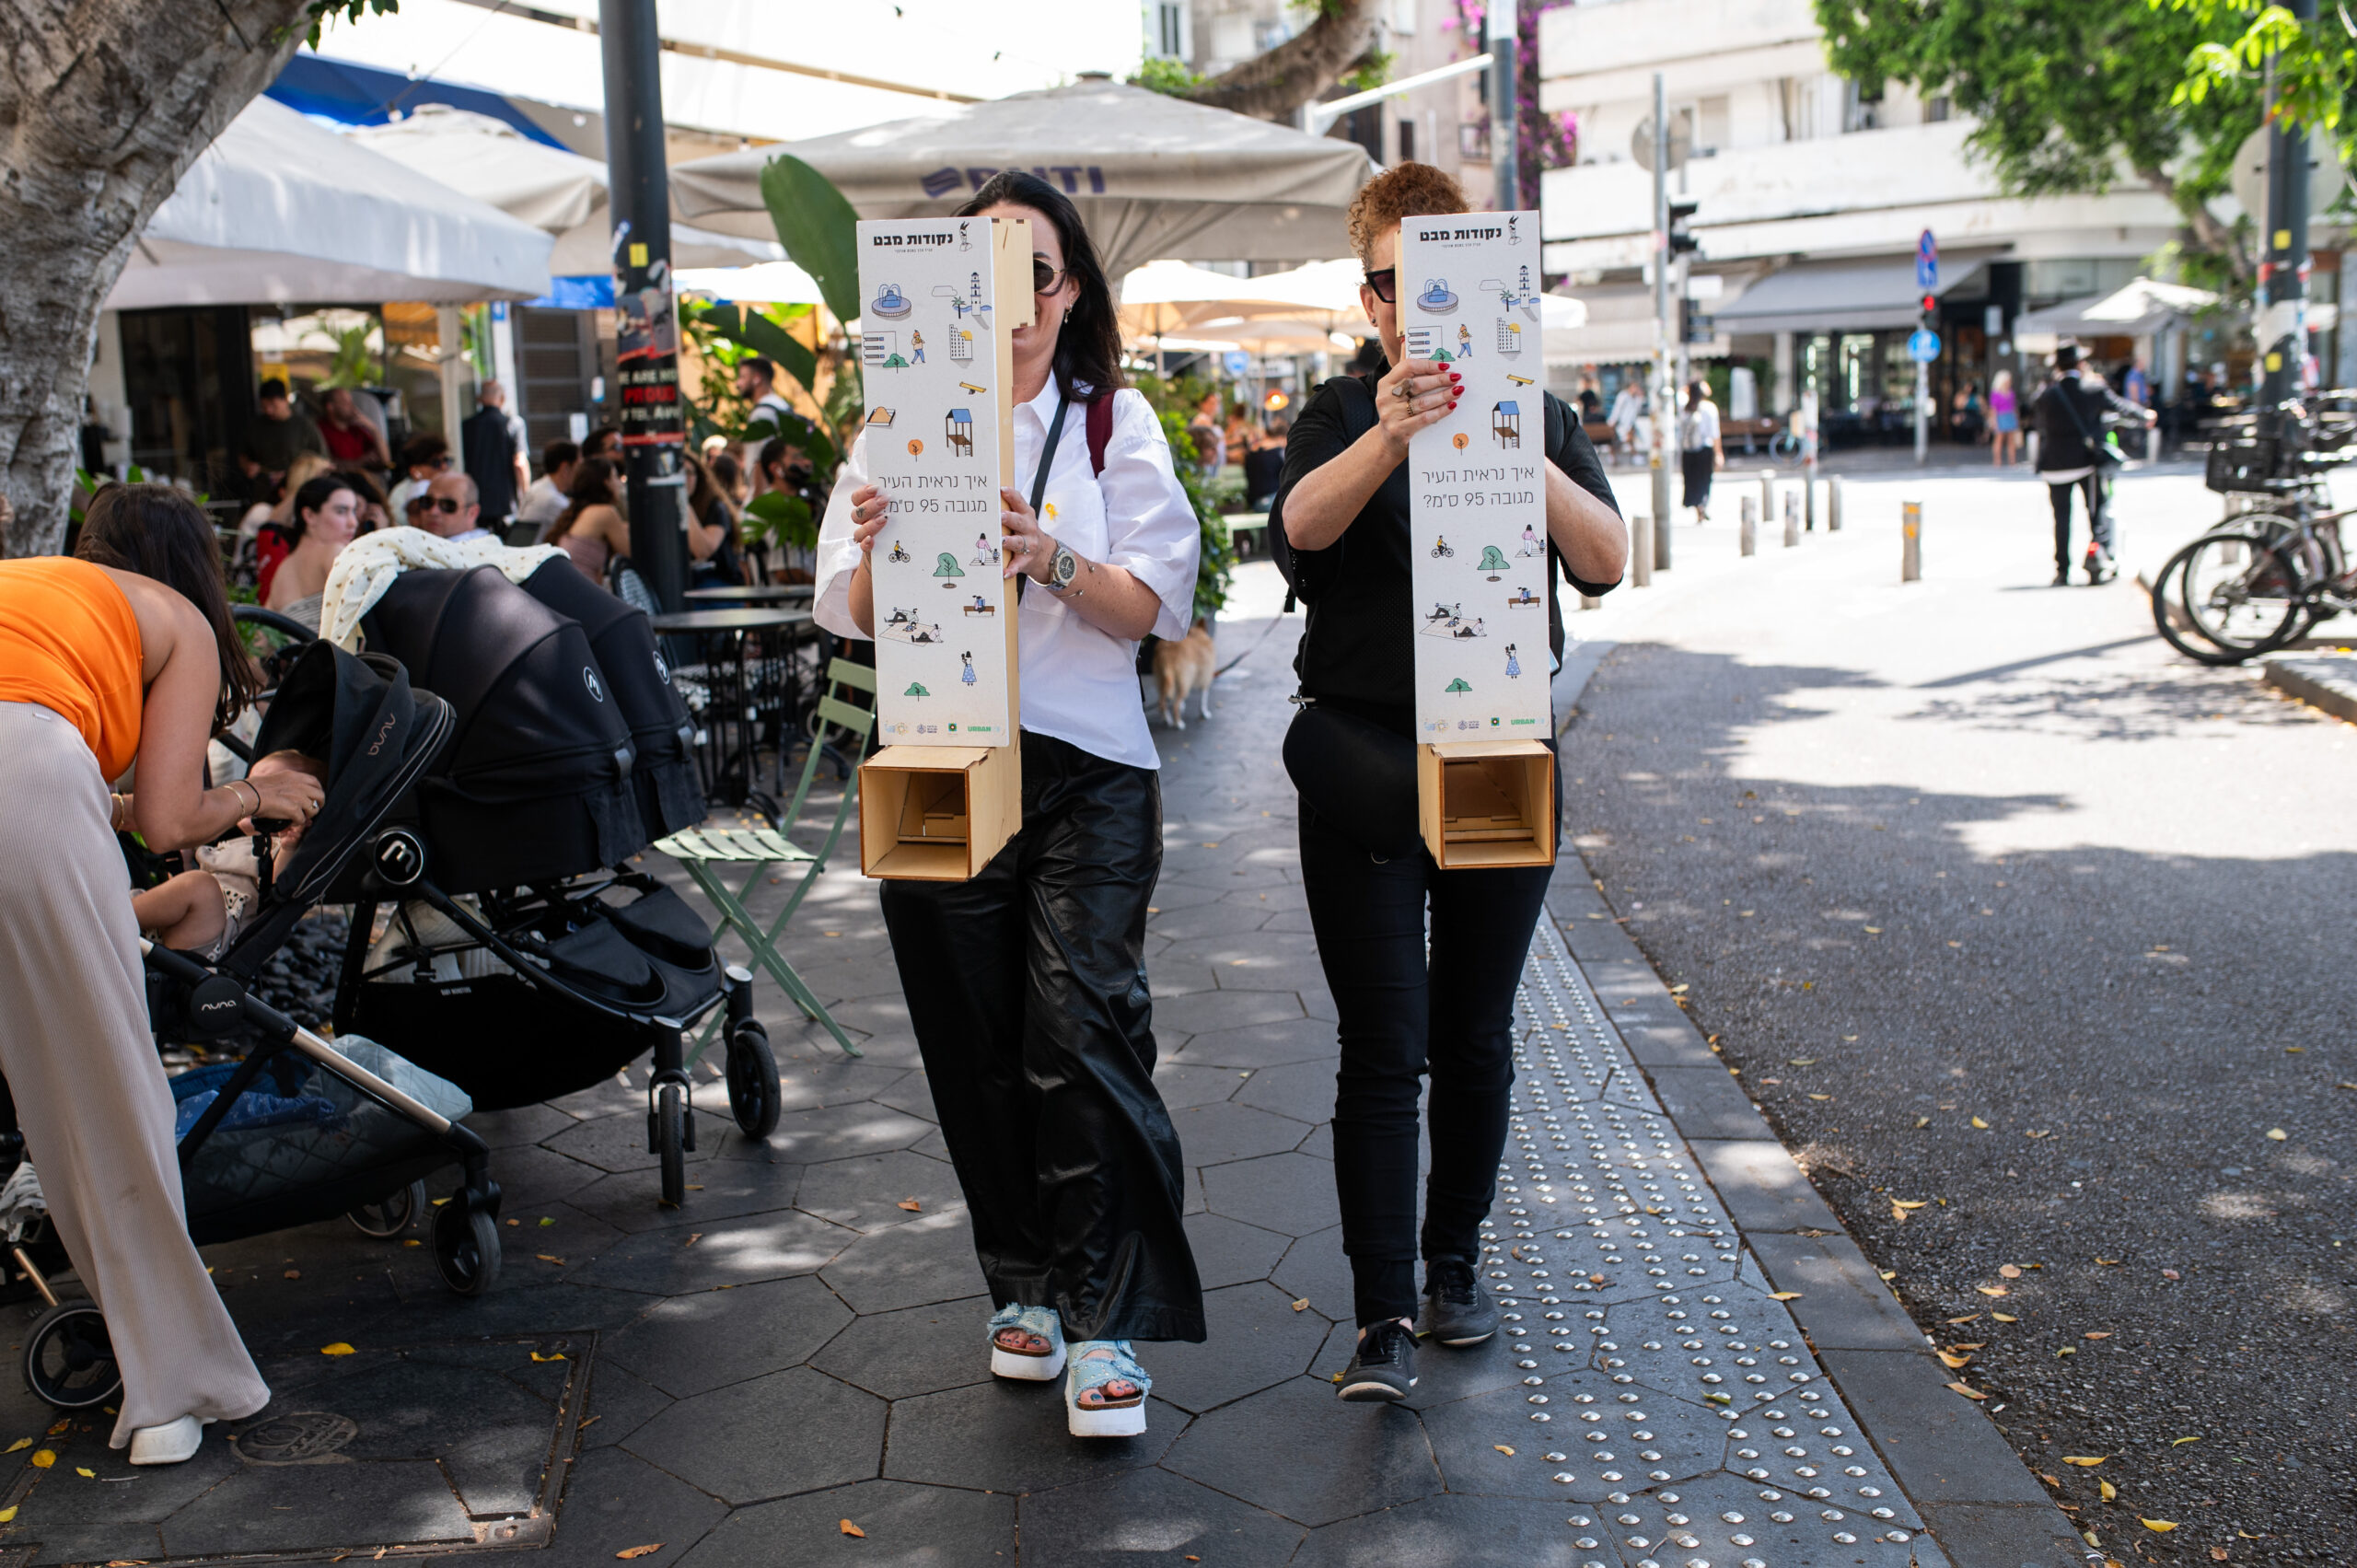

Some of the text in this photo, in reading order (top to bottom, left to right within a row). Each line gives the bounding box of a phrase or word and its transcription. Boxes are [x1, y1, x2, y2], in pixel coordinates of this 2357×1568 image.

[873, 233, 953, 246] נקודות מבט
[1420, 227, 1502, 241] נקודות מבט
[633, 370, 657, 383] ARE
[624, 387, 676, 403] PROUD
[1422, 467, 1535, 483] איך נראית העיר
[878, 475, 988, 490] איך נראית העיר
[1465, 492, 1484, 506] 95
[1491, 491, 1534, 505] מגובה
[921, 498, 939, 513] 95
[945, 499, 987, 513] מגובה
[201, 1000, 237, 1011] nuna
